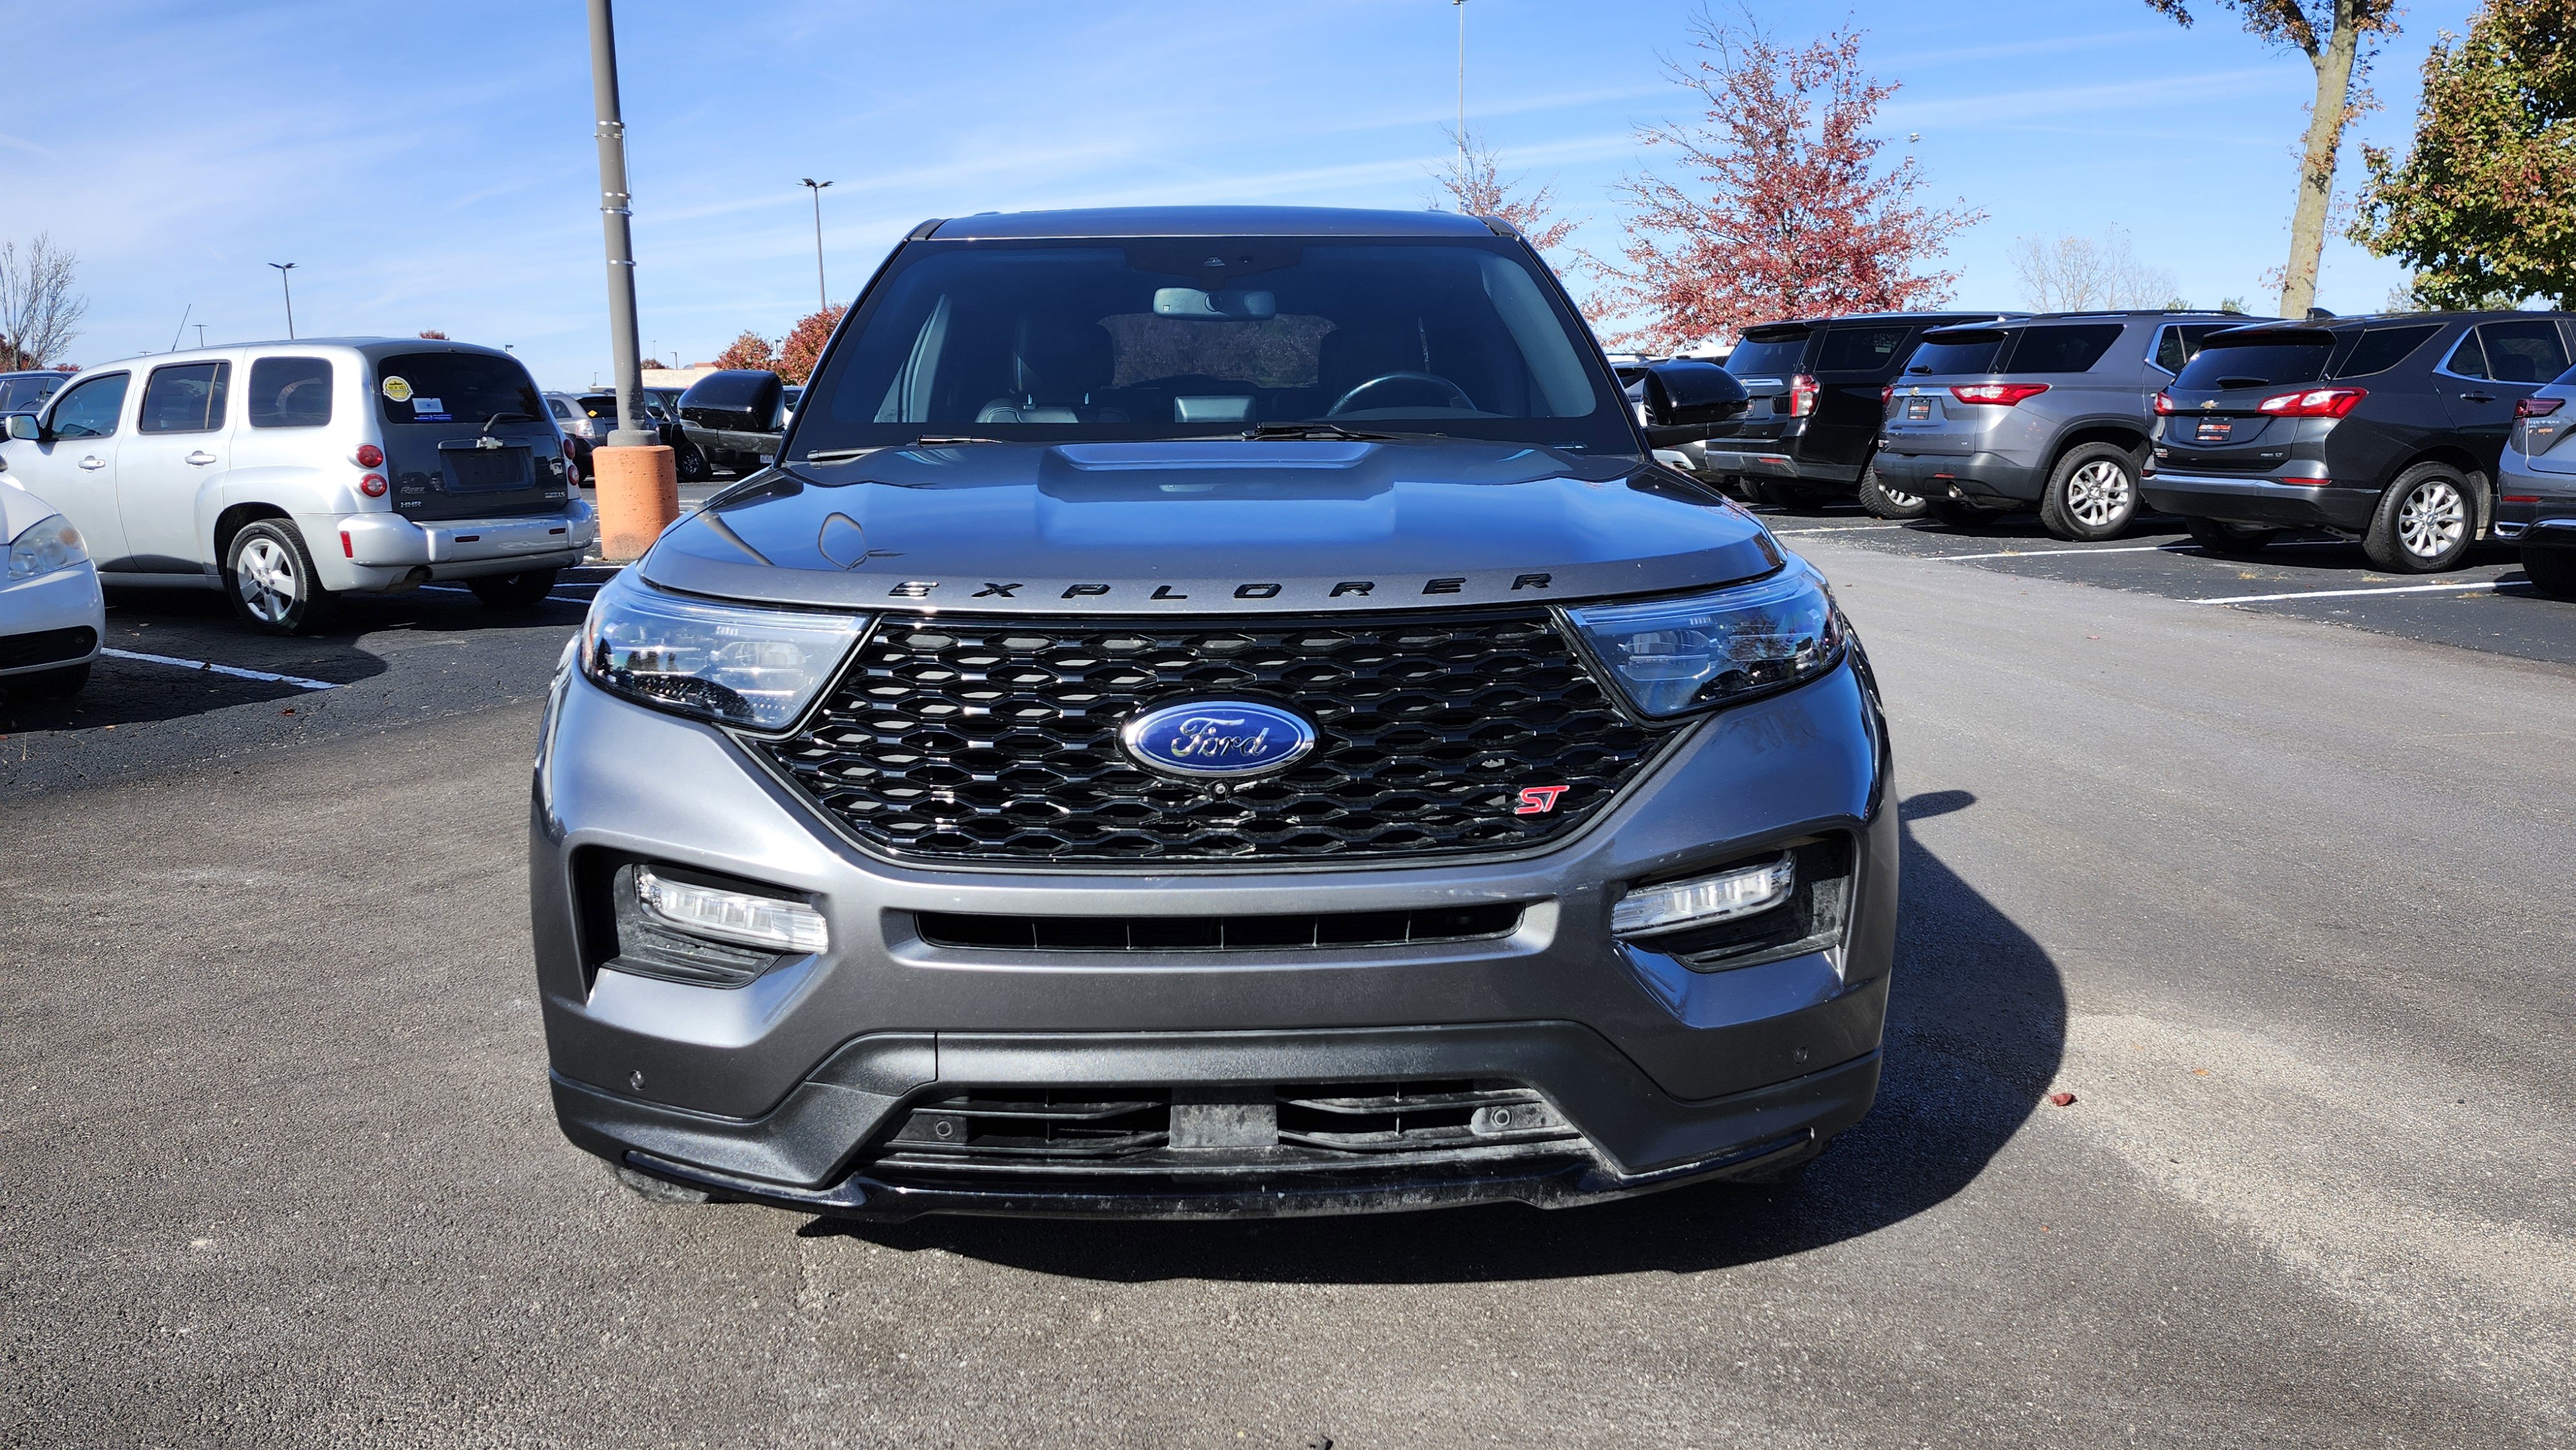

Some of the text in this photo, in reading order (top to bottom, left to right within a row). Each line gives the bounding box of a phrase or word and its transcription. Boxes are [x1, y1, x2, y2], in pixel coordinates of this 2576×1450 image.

[888, 573, 1553, 599] EXPLORER
[1171, 716, 1270, 757] Ford
[1515, 785, 1570, 815] ST
